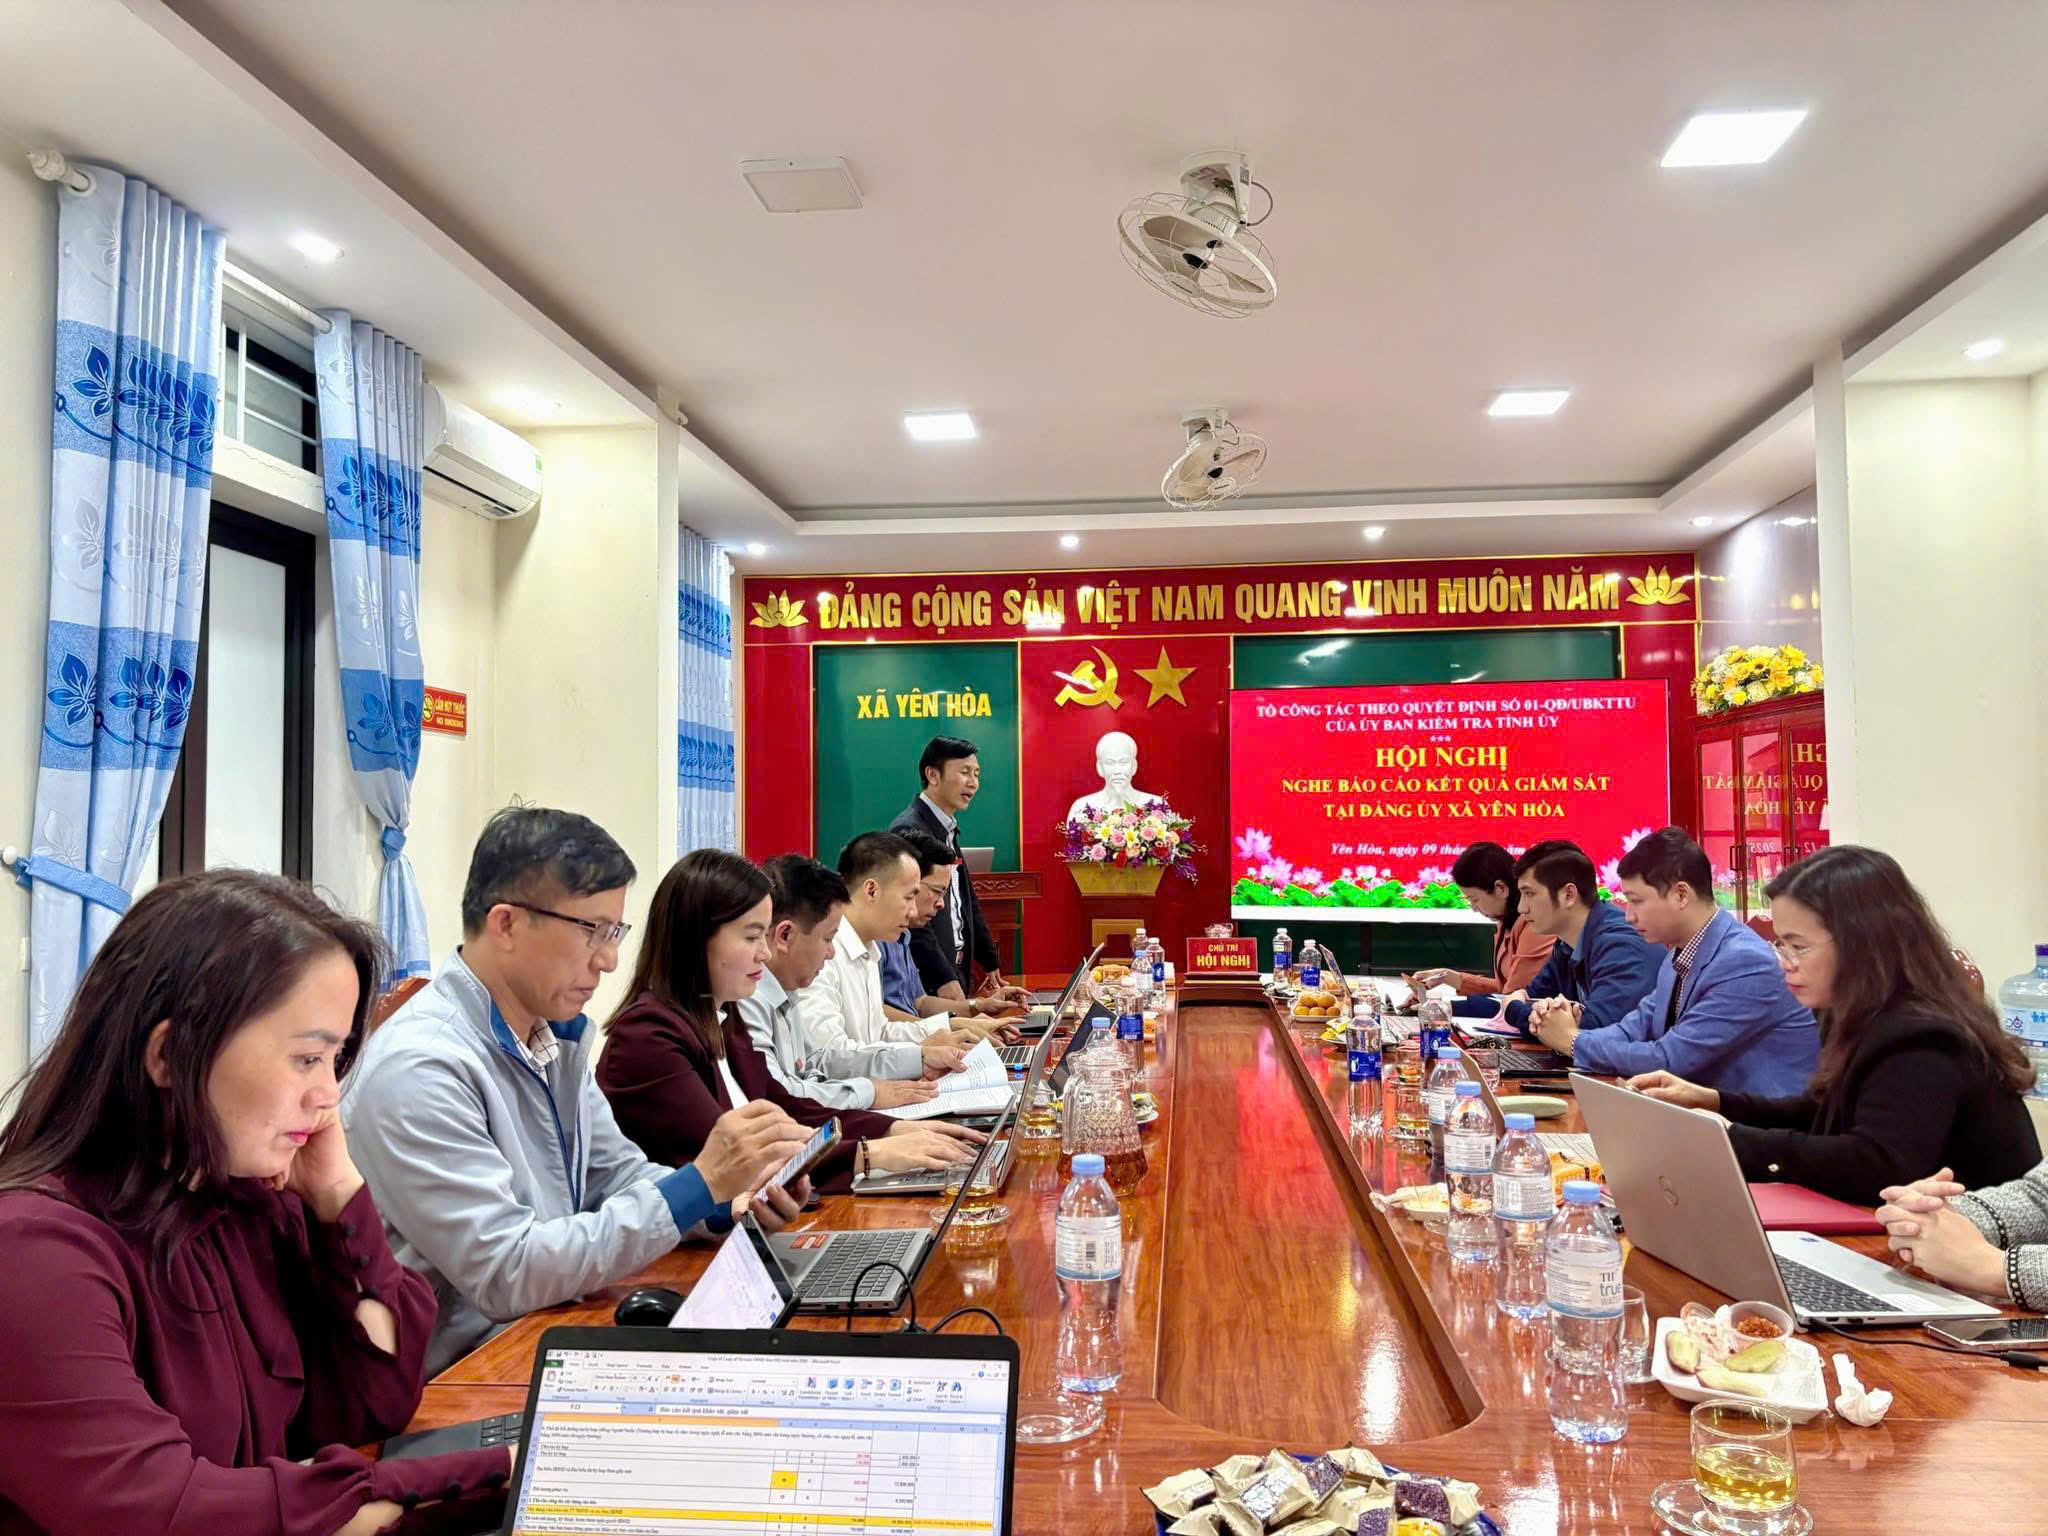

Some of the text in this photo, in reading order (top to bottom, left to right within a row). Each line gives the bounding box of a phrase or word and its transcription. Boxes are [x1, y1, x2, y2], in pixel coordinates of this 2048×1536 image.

[818, 565, 1620, 635] ĐẢNG CỘNG SẢN VIỆT NAM QUANG VINH MUÔN NĂM
[857, 686, 992, 719] XÃ YÊN HÒA
[1279, 703, 1321, 717] CÔNG
[1324, 701, 1355, 716] TÁC
[1357, 702, 1399, 716] THEO
[1402, 701, 1455, 717] QUYẾT
[1458, 699, 1497, 715] ĐỊNH
[1524, 696, 1637, 712] 01-QĐ/UBKTTU
[1383, 718, 1414, 731] BAN
[1461, 715, 1493, 729] TRA
[1376, 744, 1508, 773] HỘI NGHỊ
[1281, 772, 1611, 795] NGHE BÁO CÁO KẾT QUẢ GIÁM SÁT
[1323, 802, 1355, 821] TẠI
[1359, 800, 1413, 818] ĐẢNG
[1447, 800, 1474, 817] XÃ
[1479, 799, 1517, 817] YÊN
[1522, 799, 1565, 817] HÒA
[1331, 843, 1354, 855] Yên
[1357, 842, 1386, 857] Hòa,
[1389, 844, 1419, 858] ngày
[1421, 843, 1438, 855] 09
[1208, 941, 1239, 953] CHỦ TRÌ
[1196, 953, 1251, 969] HỘI NGHỊ
[1600, 1283, 1622, 1297] true
